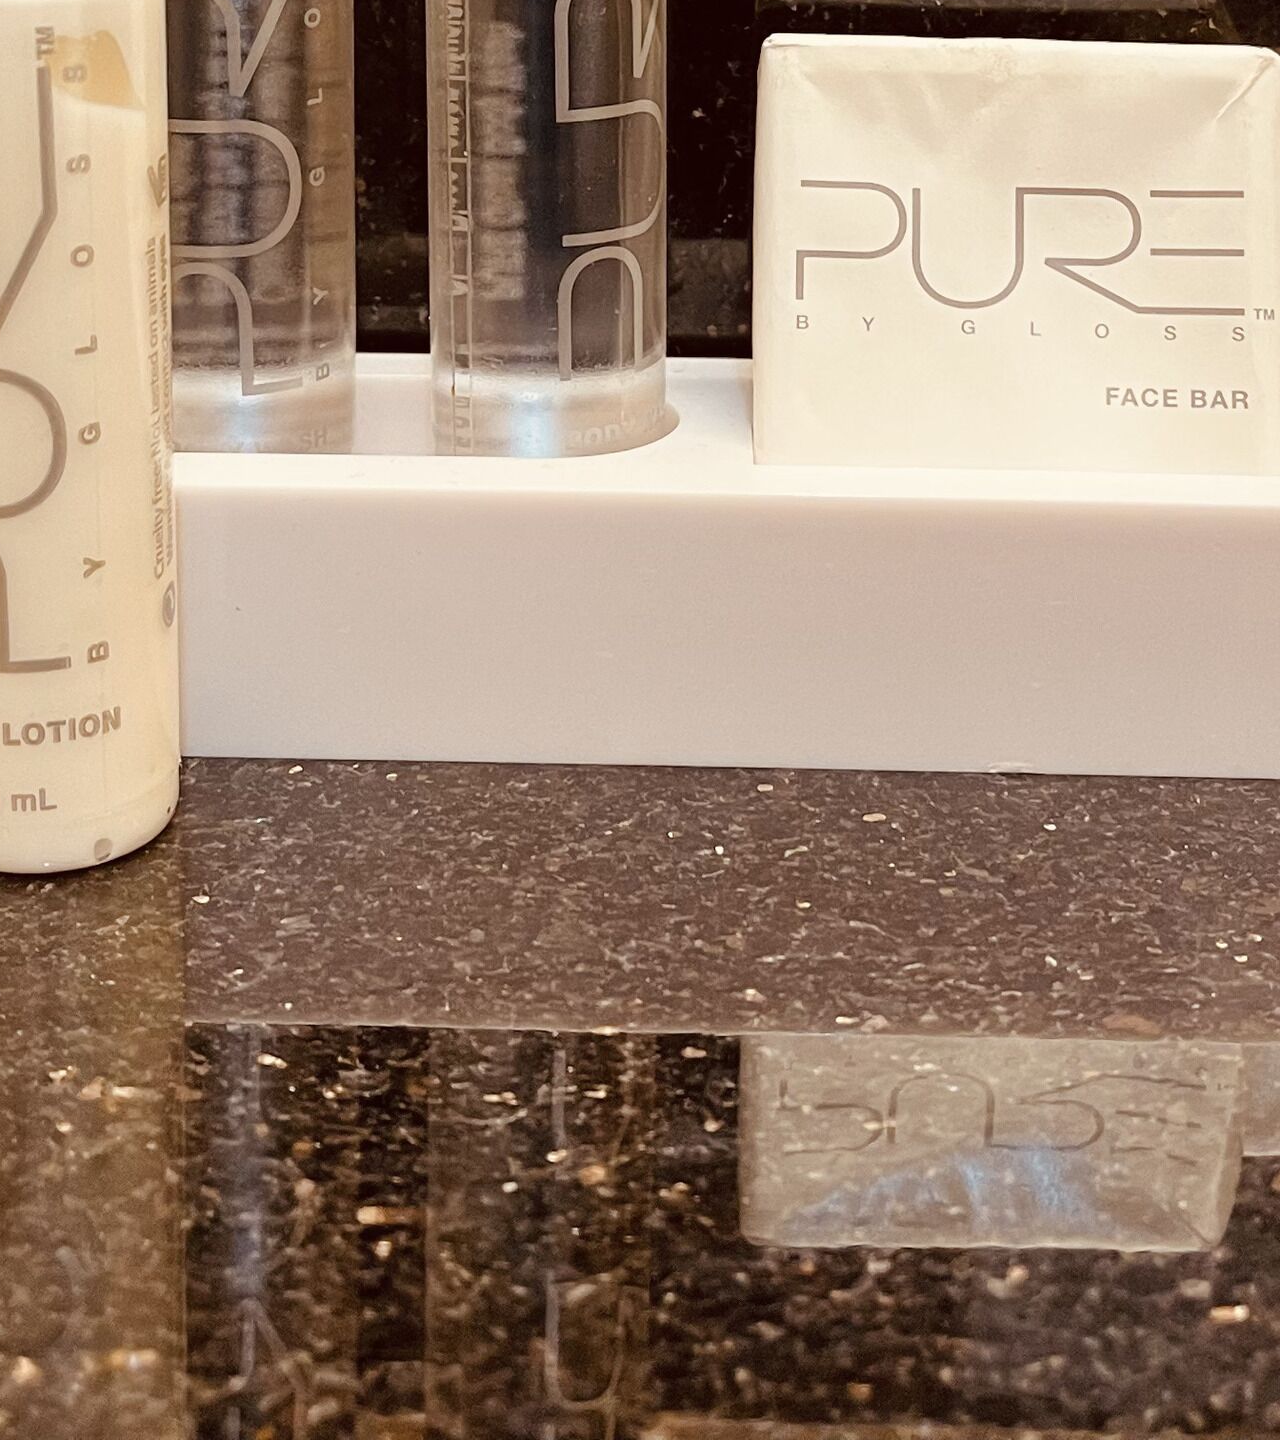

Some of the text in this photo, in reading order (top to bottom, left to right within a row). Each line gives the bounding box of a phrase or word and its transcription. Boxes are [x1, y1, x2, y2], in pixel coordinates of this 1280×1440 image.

[61, 63, 103, 446] GLOSS
[795, 178, 1246, 316] PURE
[145, 236, 157, 316] animals
[795, 314, 1247, 343] BY GLOSS
[1104, 385, 1252, 412] FACE BAR
[152, 507, 165, 579] Cruelty
[1, 705, 122, 747] LOTION
[10, 785, 59, 813] mL
